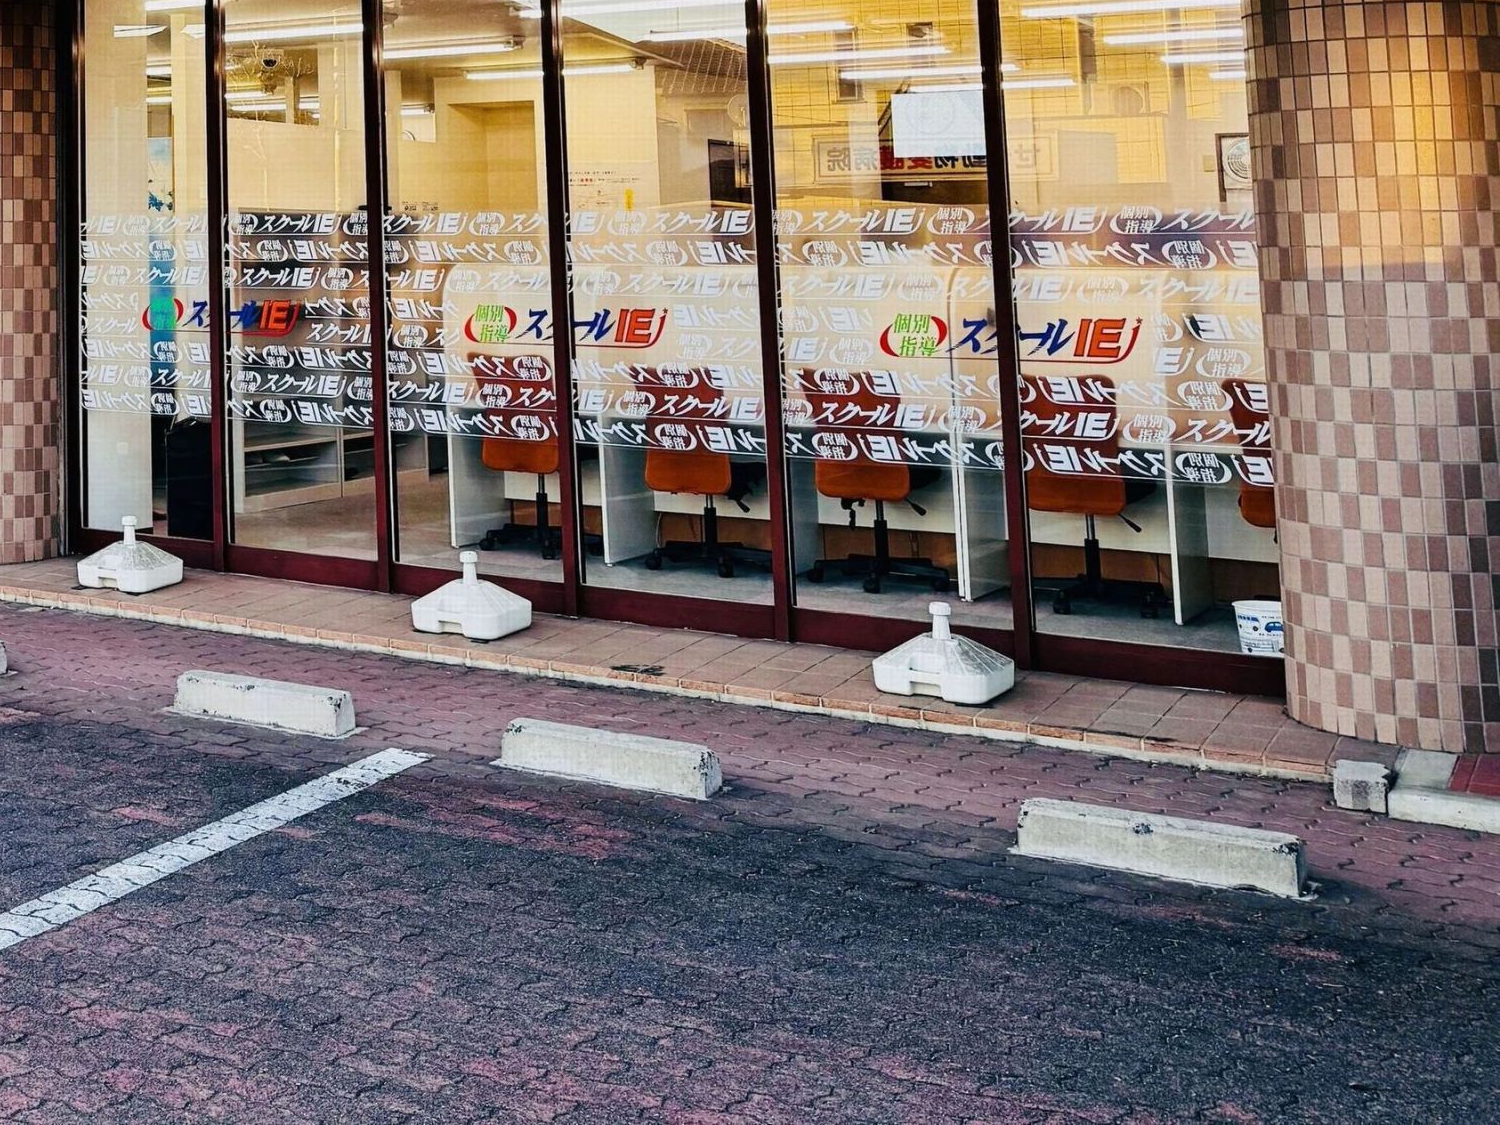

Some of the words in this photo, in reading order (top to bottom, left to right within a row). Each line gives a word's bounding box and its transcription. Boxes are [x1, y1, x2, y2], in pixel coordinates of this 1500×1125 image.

[257, 214, 336, 233] スクールIE
[647, 209, 751, 233] スクールIE
[801, 208, 916, 232] スクールIE
[237, 267, 314, 287] スクールIE
[619, 274, 723, 294] スクールIE
[475, 305, 504, 322] 個別
[894, 314, 931, 333] 個別
[480, 324, 509, 342] 指導
[900, 337, 938, 357] 指導
[260, 375, 340, 395] スクールIE
[656, 395, 762, 419] スクールIE
[812, 402, 927, 427] スクールIE
